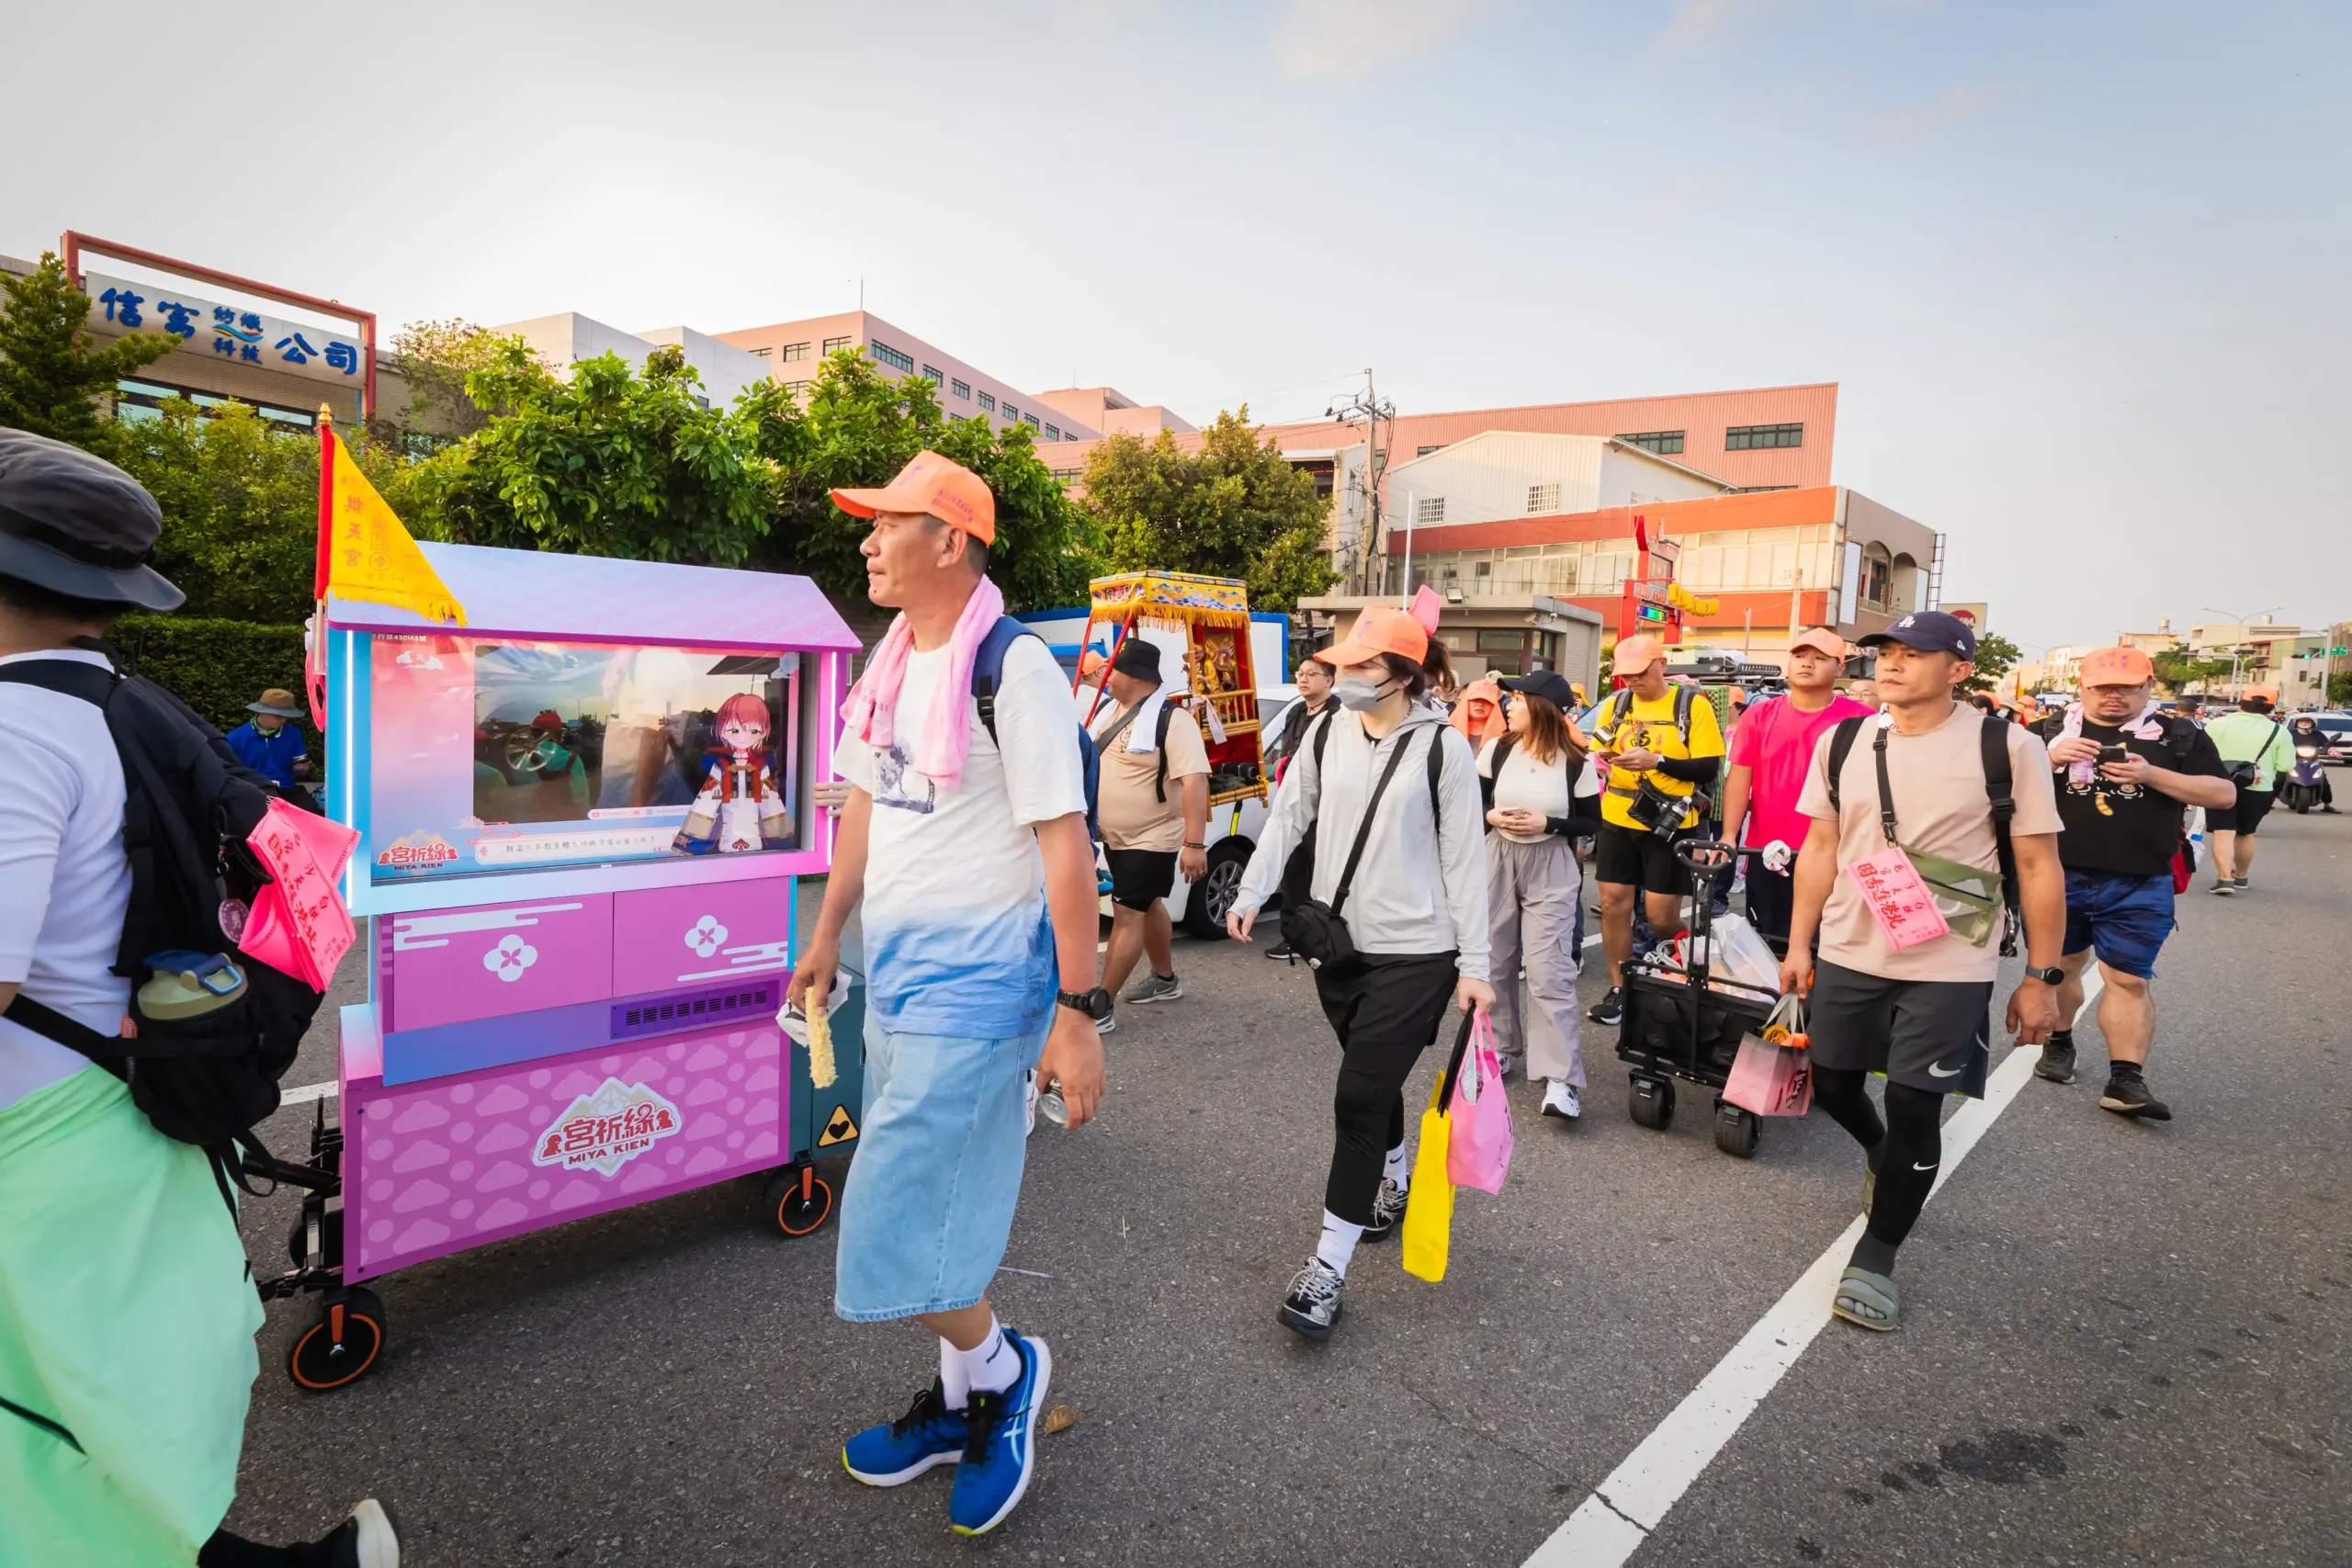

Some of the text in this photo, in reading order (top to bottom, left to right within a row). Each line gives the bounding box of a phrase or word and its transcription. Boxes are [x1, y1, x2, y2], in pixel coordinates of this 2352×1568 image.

[99, 287, 200, 339] 信富
[213, 337, 263, 364] 科技
[275, 333, 357, 376] 公司
[391, 843, 446, 863] 宮祈緣
[1857, 862, 1906, 930] 北港進香團
[563, 1103, 655, 1152] 宮祈緣
[569, 1138, 650, 1165] MIYA KIEN
